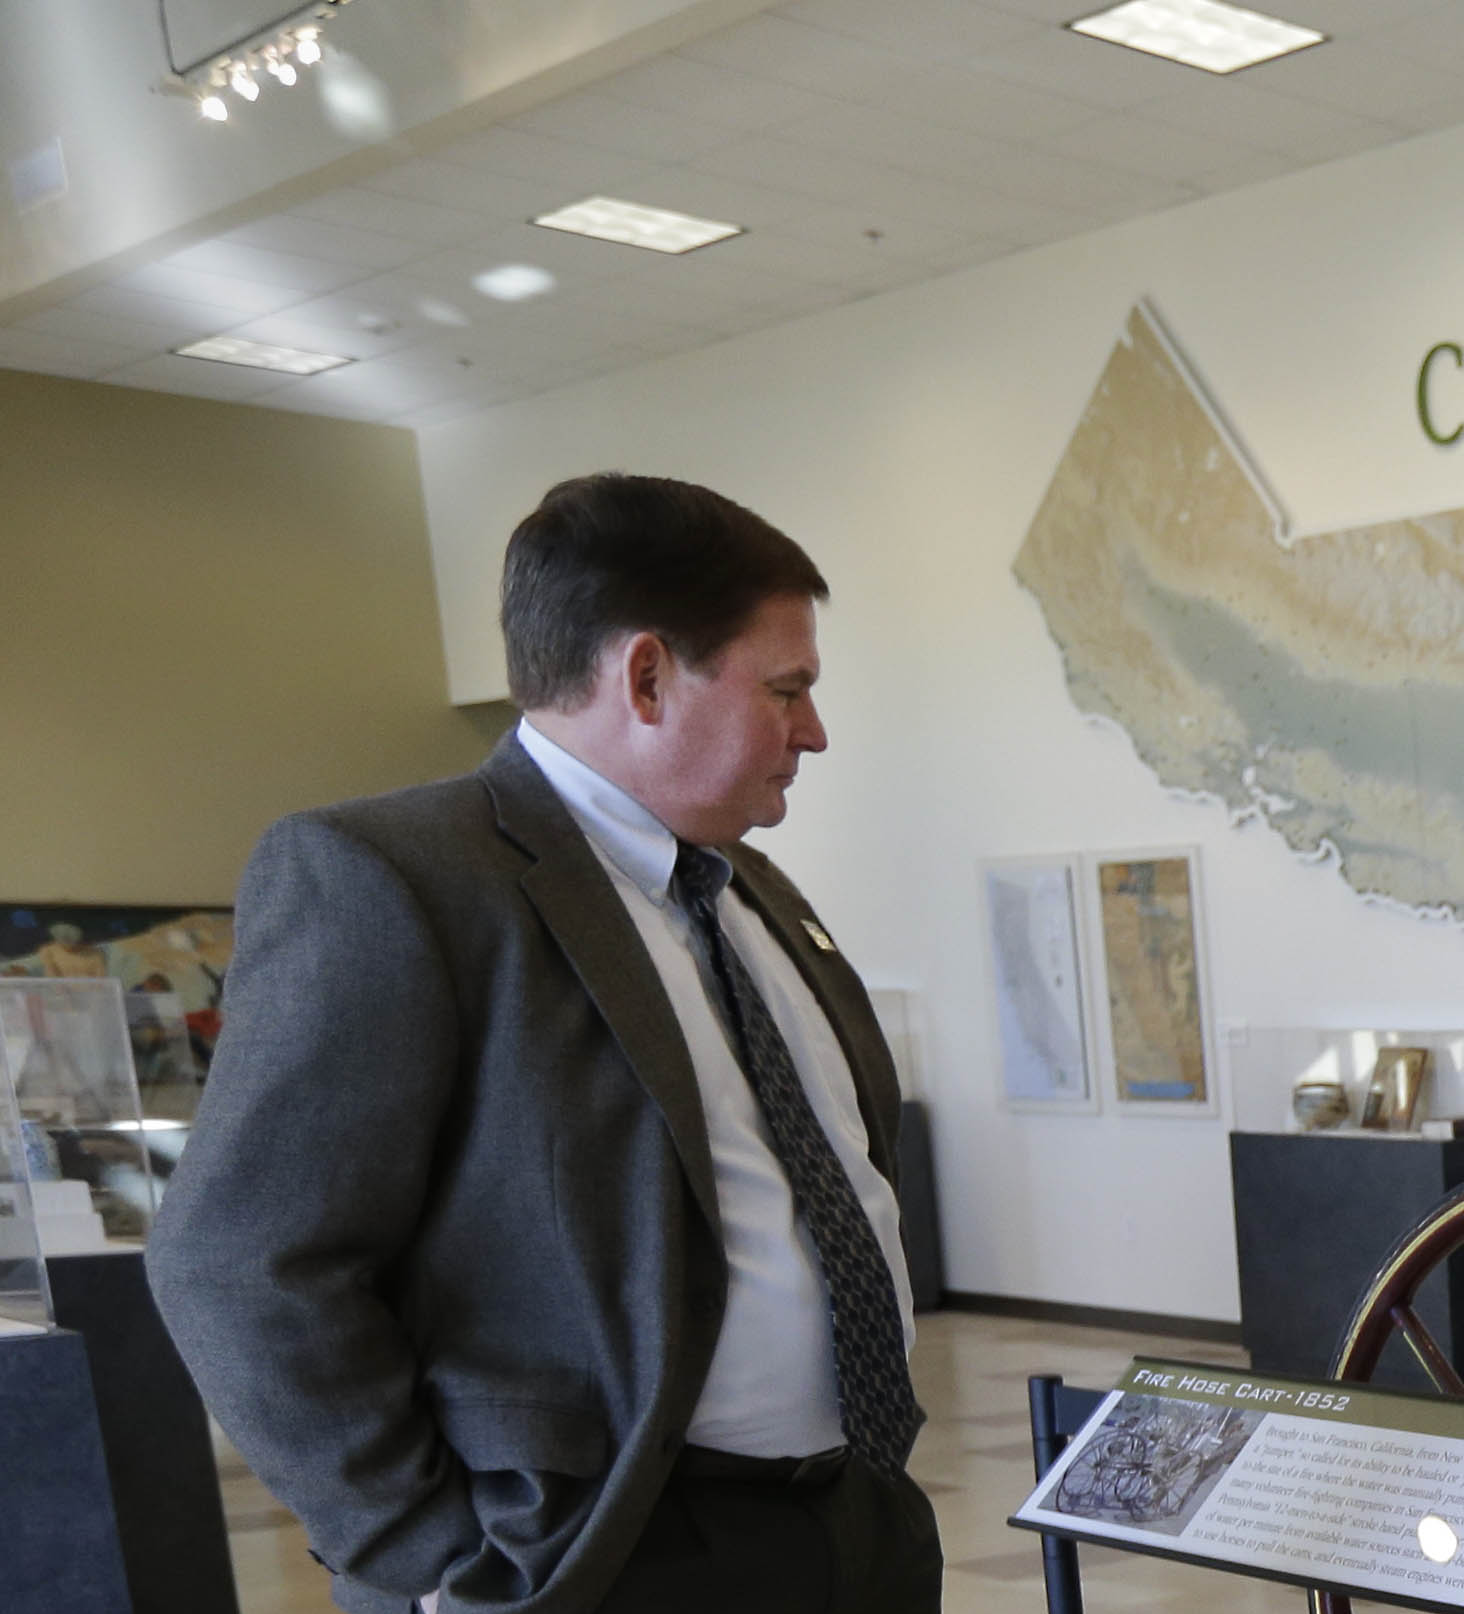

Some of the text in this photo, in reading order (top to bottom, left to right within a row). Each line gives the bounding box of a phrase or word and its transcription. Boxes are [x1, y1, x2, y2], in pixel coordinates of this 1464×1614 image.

[1132, 1369, 1175, 1388] FIRE
[1176, 1375, 1231, 1396] HOSE
[1446, 1474, 1461, 1484] or
